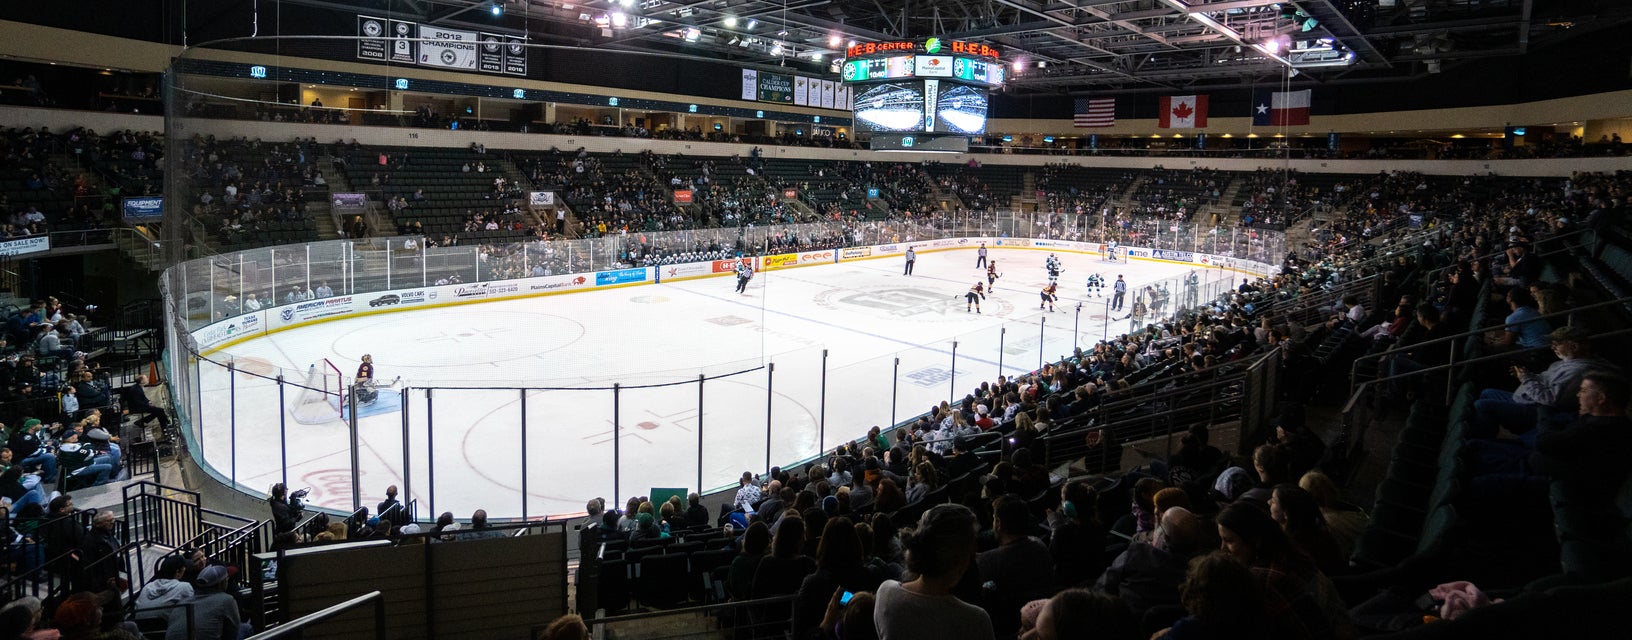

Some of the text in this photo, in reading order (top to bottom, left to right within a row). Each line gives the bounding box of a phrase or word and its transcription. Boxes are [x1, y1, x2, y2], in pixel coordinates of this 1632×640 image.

[435, 31, 462, 40] 2012
[399, 41, 406, 50] 3
[422, 40, 475, 51] CHAMPIONS
[877, 42, 913, 51] CENTER
[362, 50, 383, 58] 2008
[760, 84, 792, 92] CHAMPIONS
[127, 199, 162, 207] EQUIPMENT
[296, 301, 325, 310] AMERICAN
